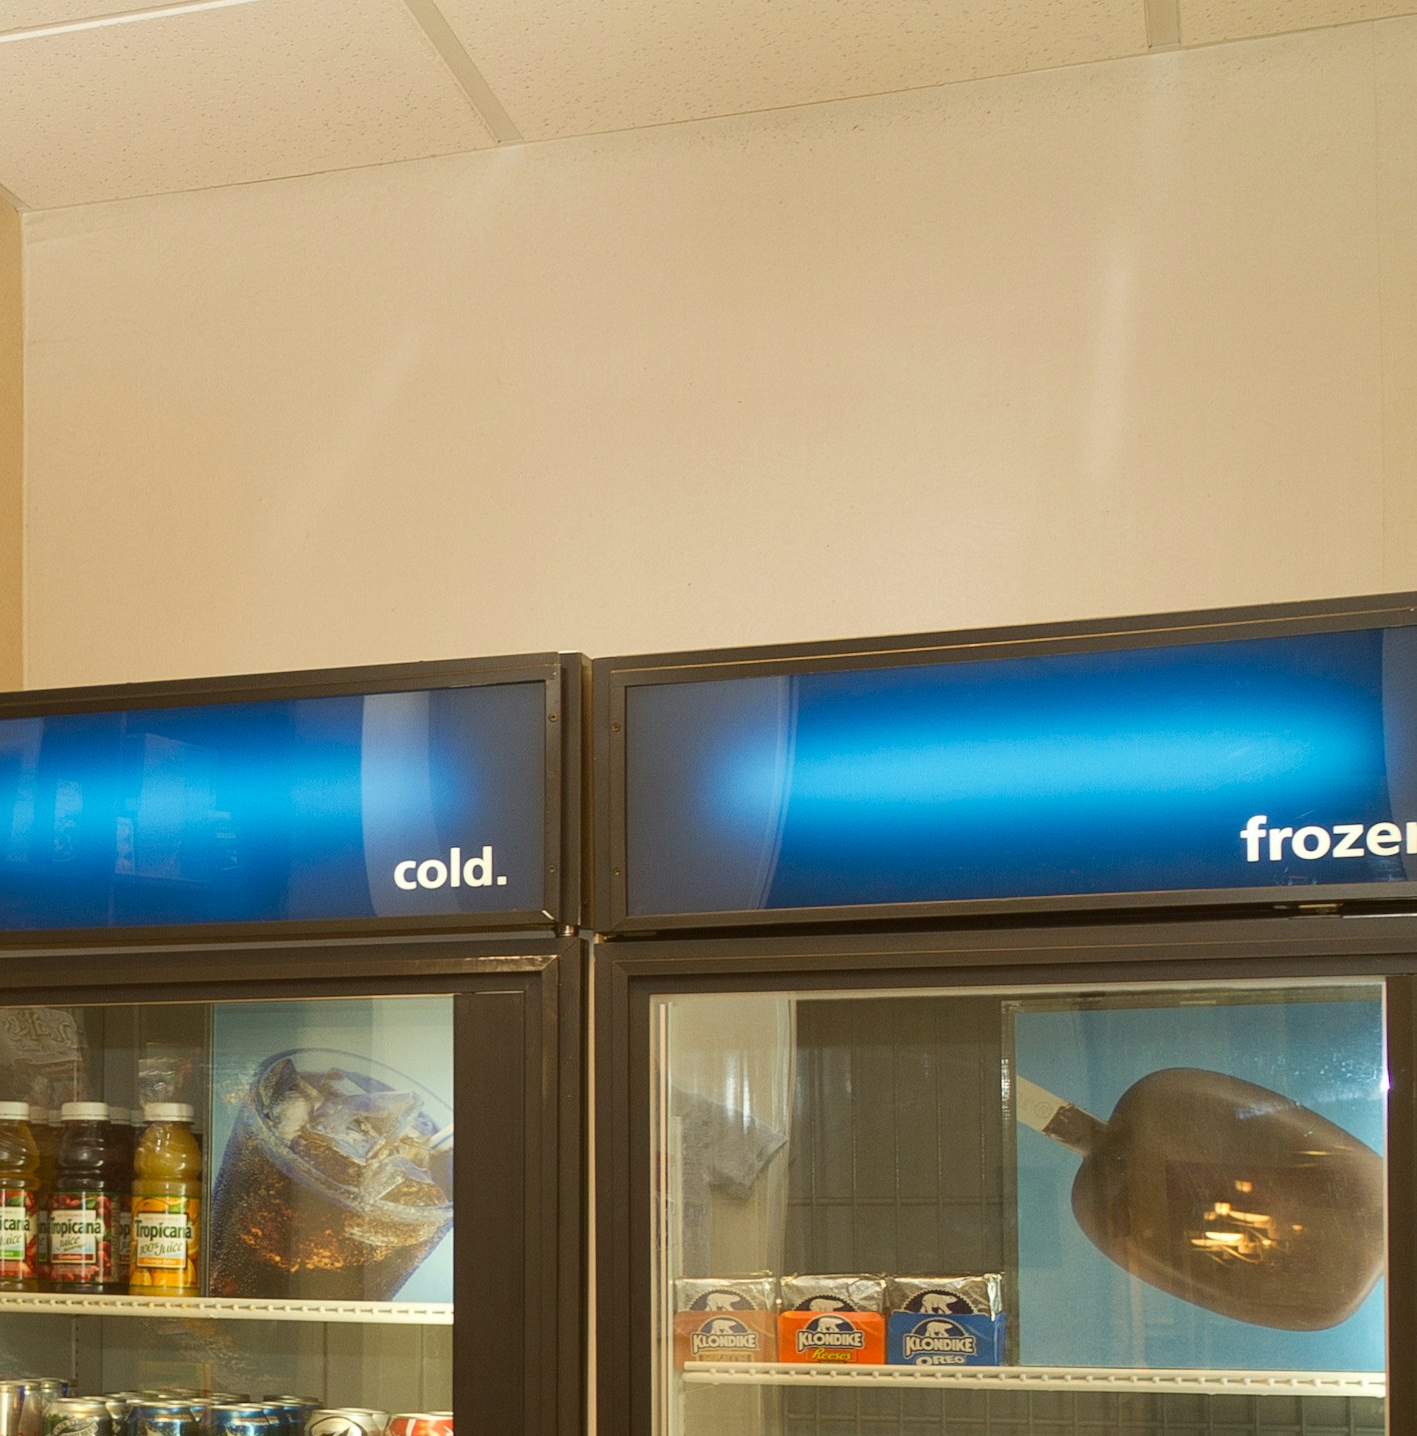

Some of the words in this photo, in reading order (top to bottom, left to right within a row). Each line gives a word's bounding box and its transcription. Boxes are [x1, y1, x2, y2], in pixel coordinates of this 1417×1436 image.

[394, 846, 507, 890] cold.
[134, 1223, 192, 1242] Tropicana
[798, 1332, 863, 1349] KLONDIKE
[906, 1337, 974, 1354] KLONDIKE
